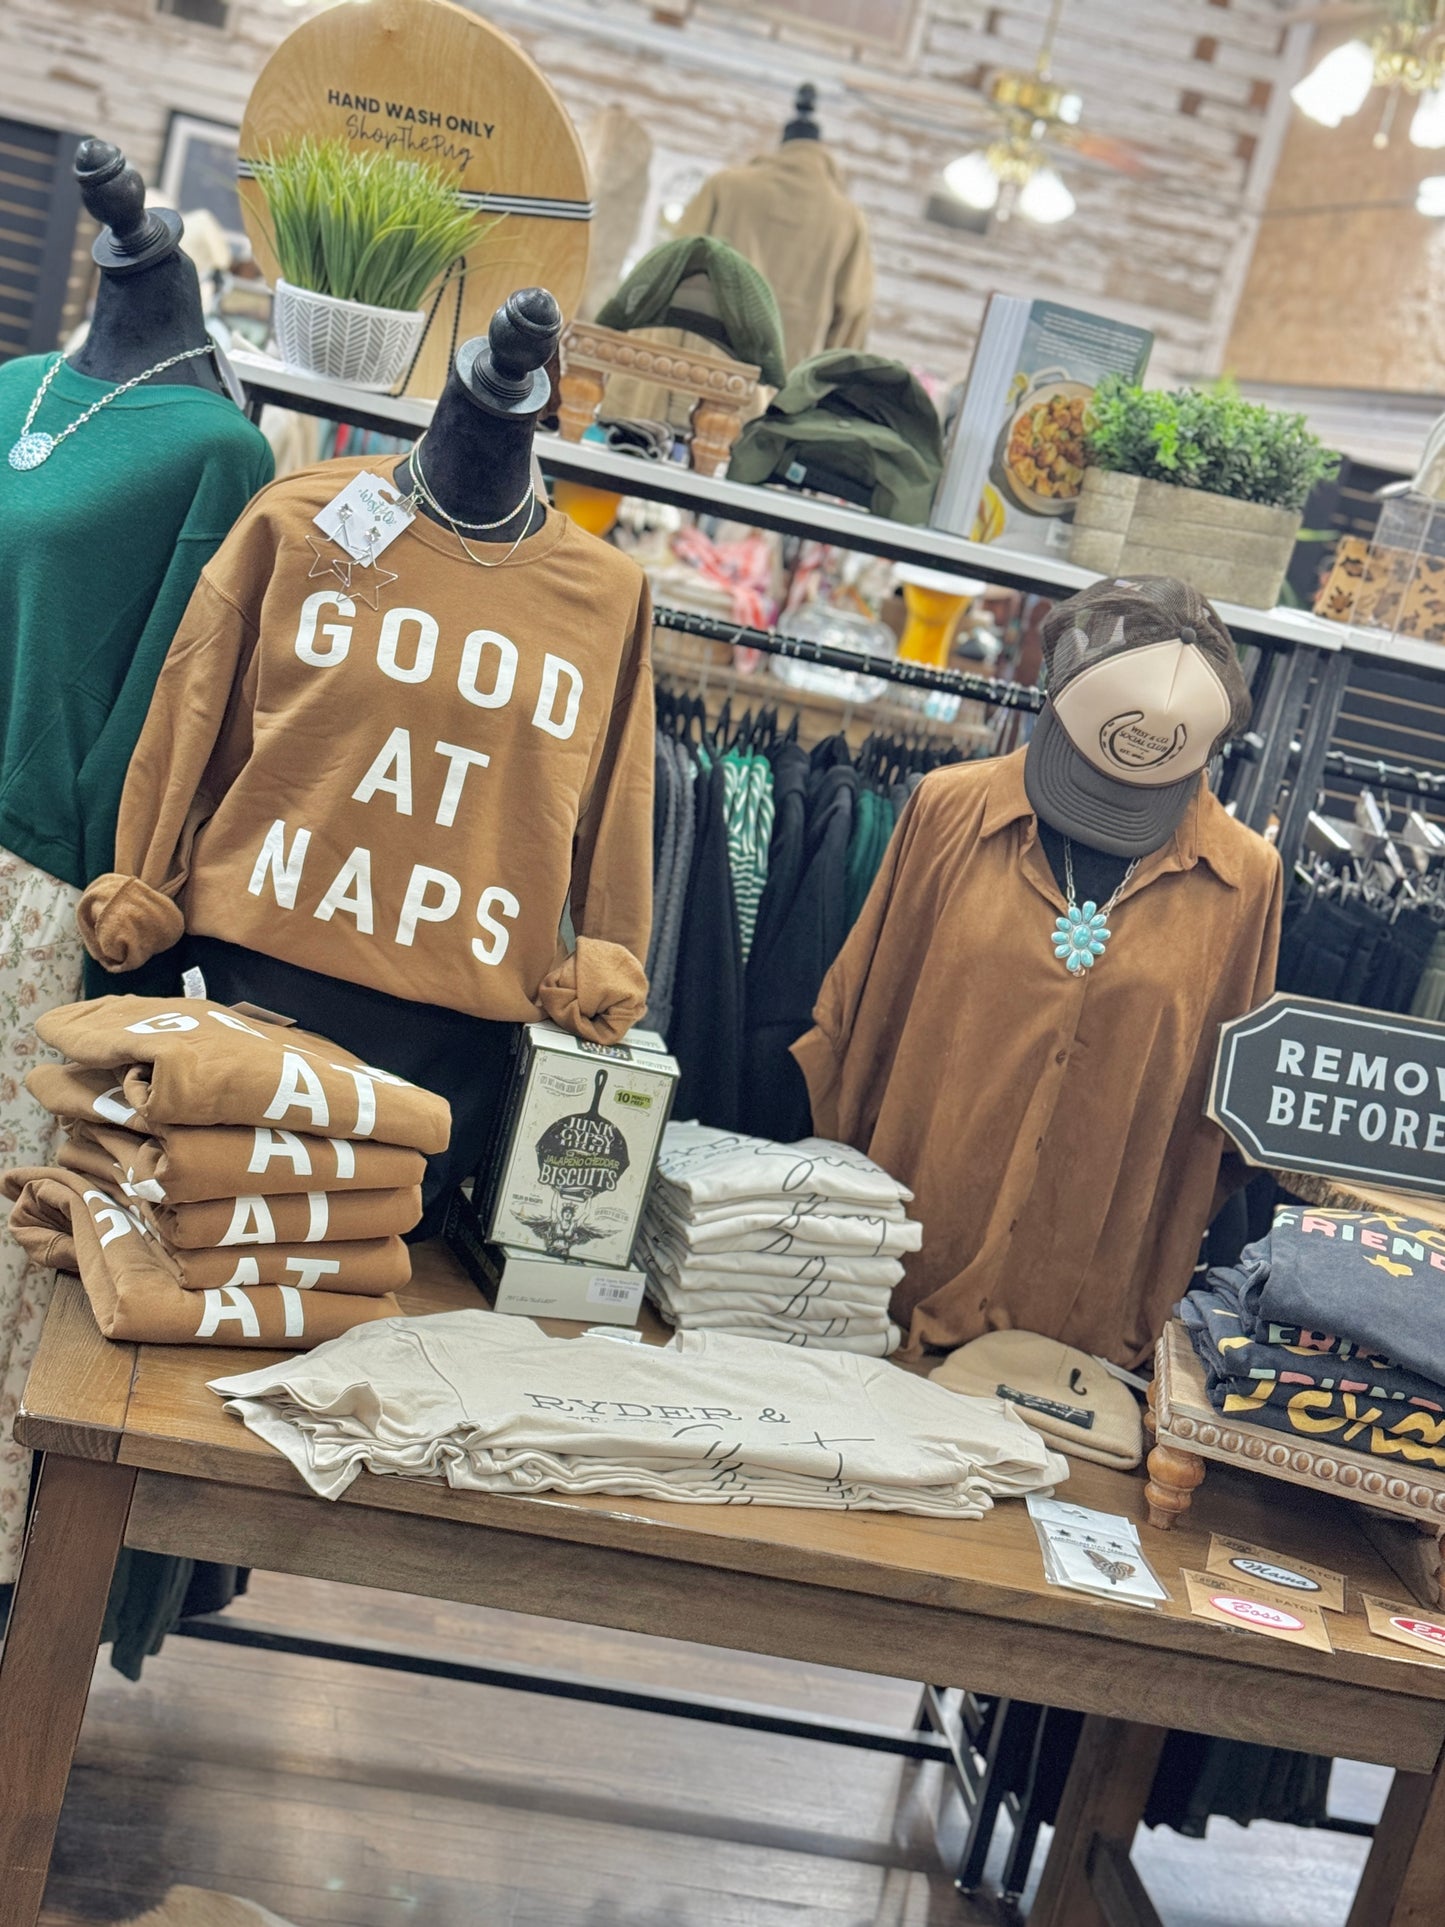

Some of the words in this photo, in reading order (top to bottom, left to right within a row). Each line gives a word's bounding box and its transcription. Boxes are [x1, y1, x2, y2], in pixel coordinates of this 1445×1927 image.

[328, 89, 380, 113] HAND
[385, 102, 441, 127] WASH
[446, 115, 495, 139] ONLY
[295, 590, 584, 740] GOOD
[1119, 730, 1145, 745] SOCIAL
[351, 726, 490, 827] AT
[248, 819, 520, 966] NAPS
[617, 1092, 630, 1104] 10
[564, 1117, 615, 1138] JUNK
[560, 1129, 616, 1149] GYPSY
[560, 1140, 612, 1155] KITCHEN
[584, 1156, 620, 1170] CHEDDAR
[539, 1163, 618, 1191] BISCUITS
[524, 1392, 743, 1422] RYDER
[758, 1407, 791, 1424] &
[1242, 1560, 1310, 1587] Mama
[1299, 1566, 1343, 1582] PATCH
[1231, 1601, 1283, 1623] Boss
[1275, 1598, 1319, 1615] PATCH
